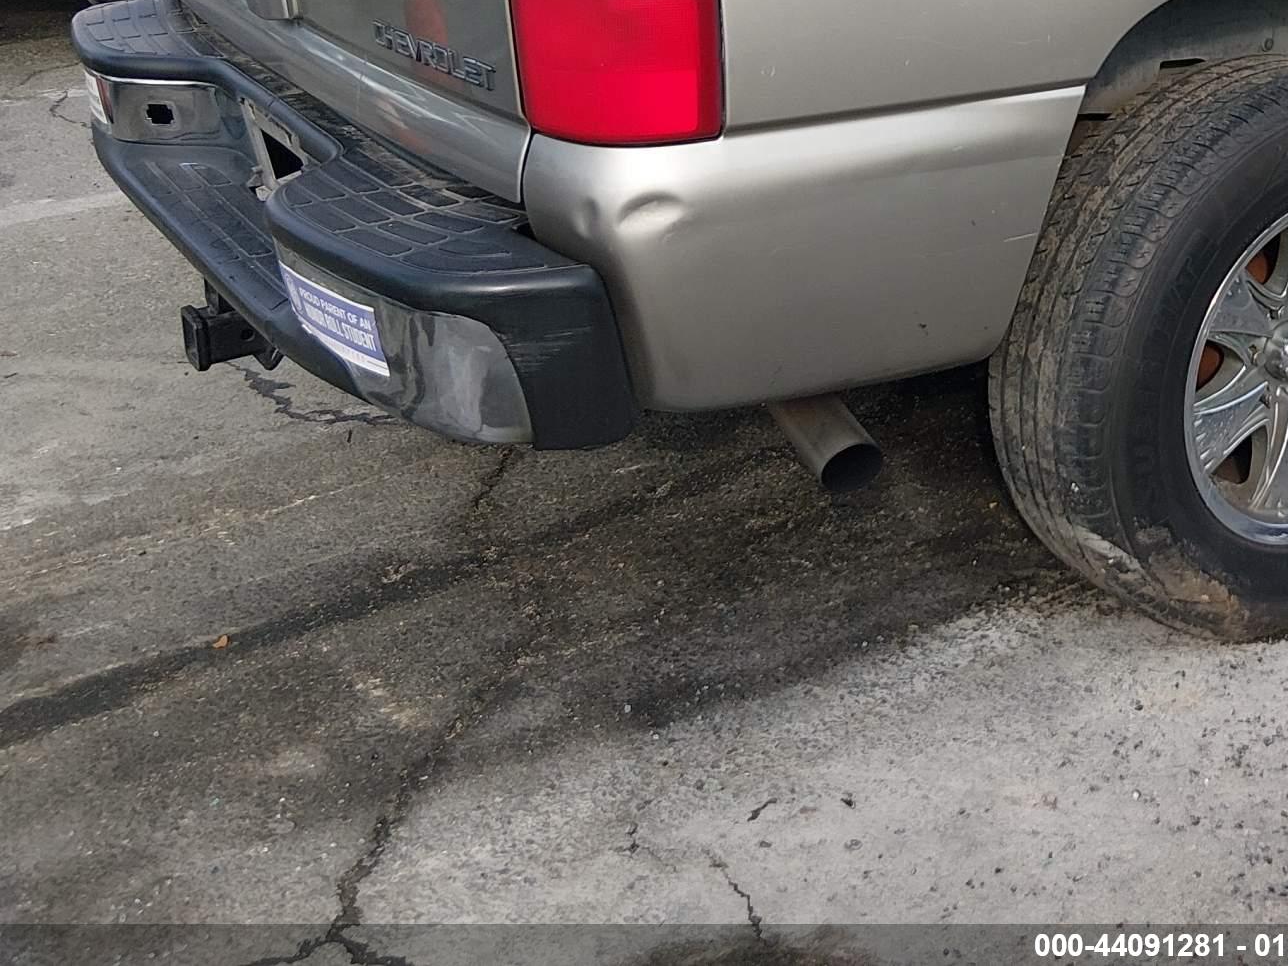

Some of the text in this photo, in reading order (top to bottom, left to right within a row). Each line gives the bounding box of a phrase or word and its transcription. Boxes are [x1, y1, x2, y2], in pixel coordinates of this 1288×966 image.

[372, 19, 497, 91] CHEVROLET
[299, 287, 372, 331] PROUD PARENT OF AN
[341, 322, 377, 352] STUDENT
